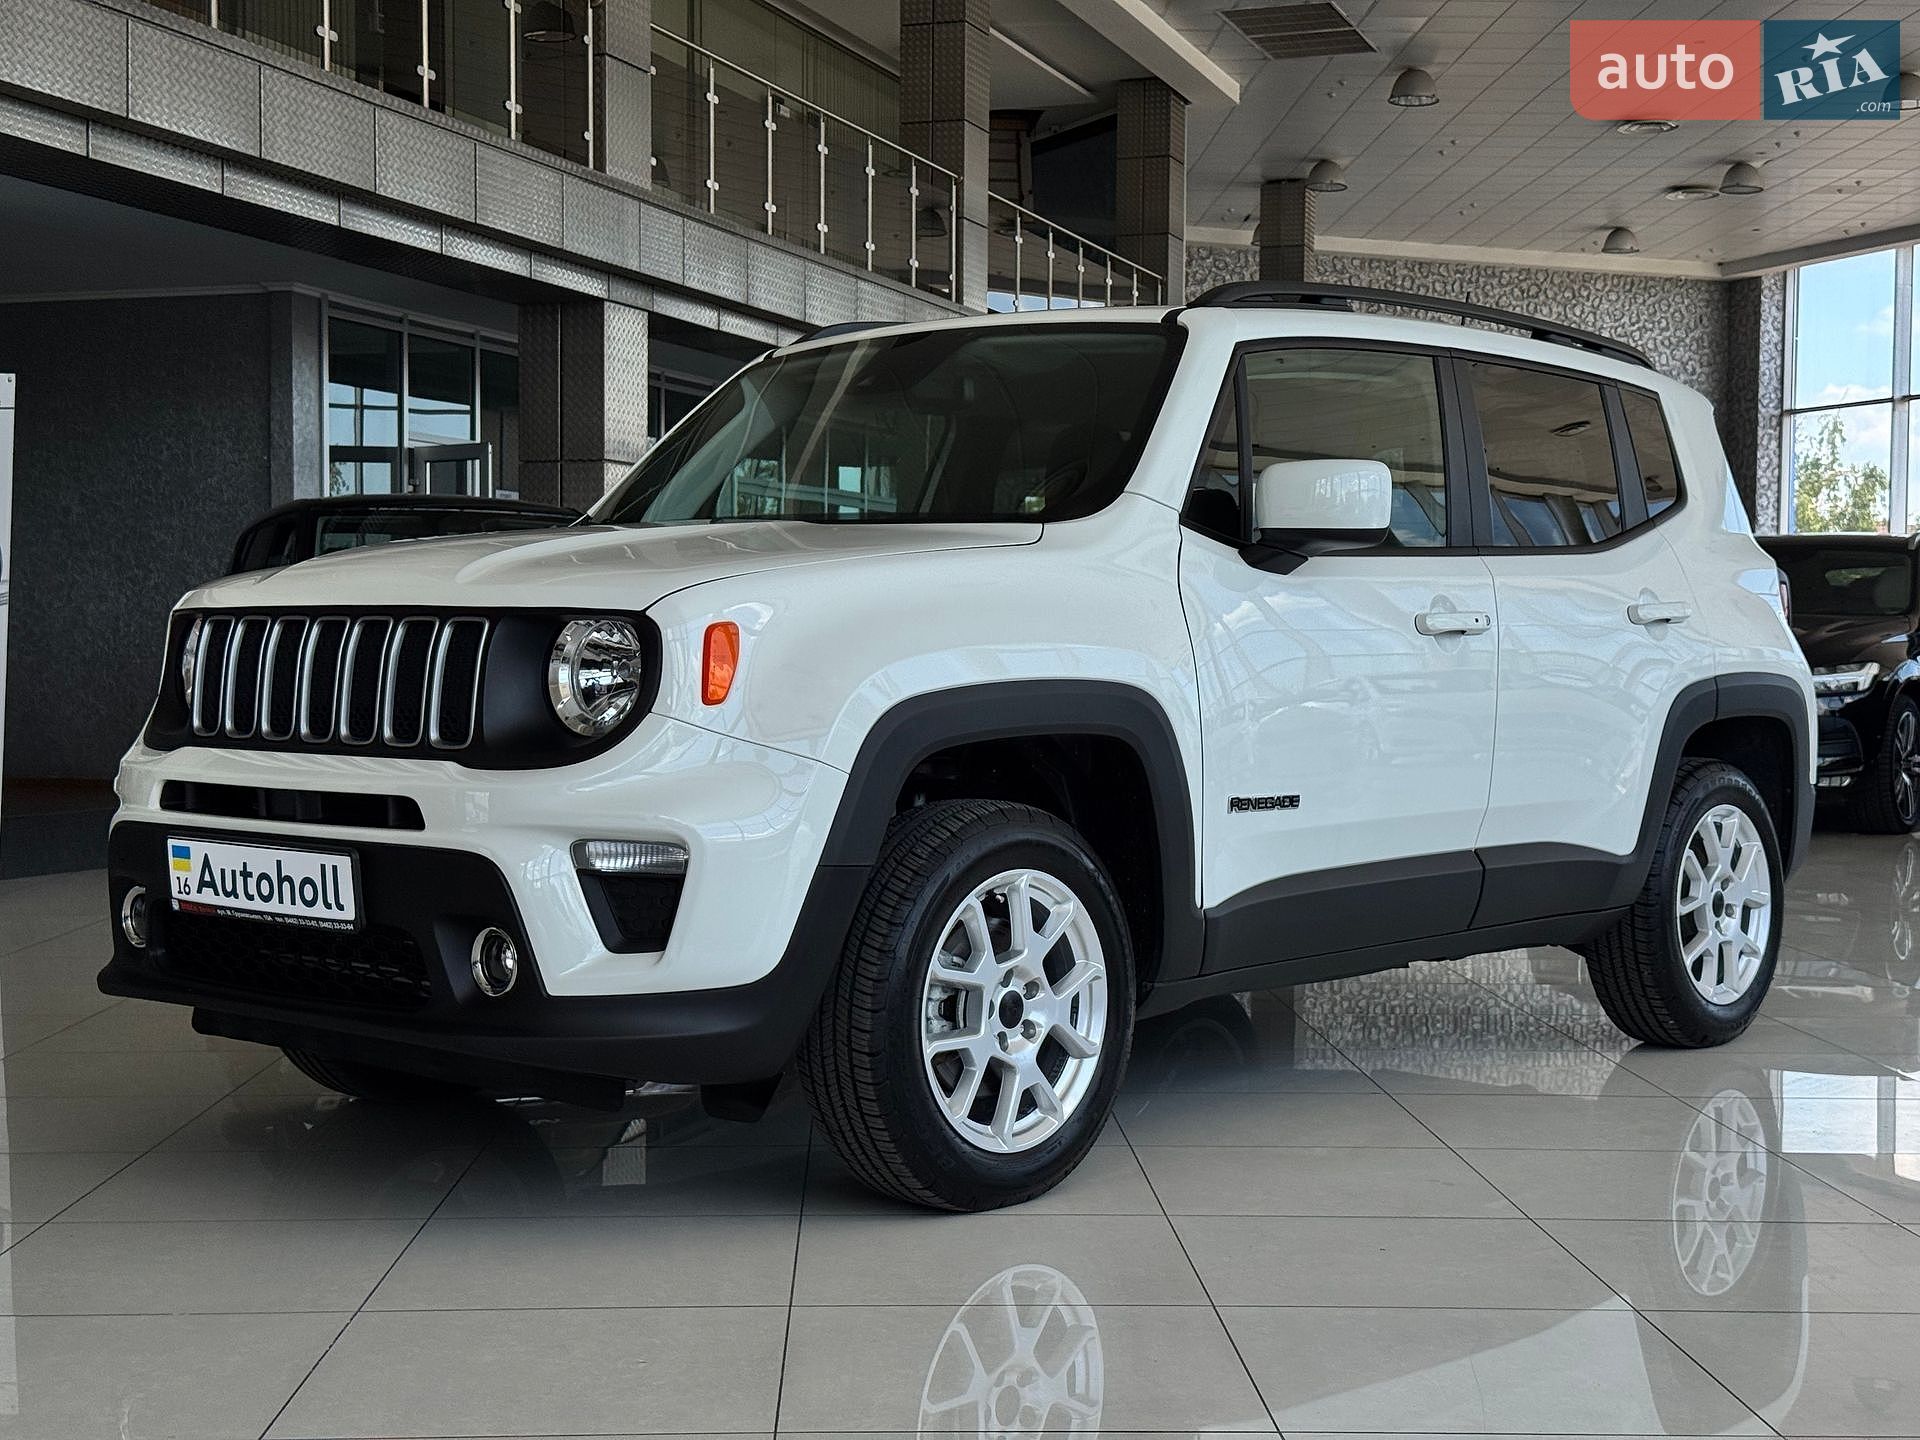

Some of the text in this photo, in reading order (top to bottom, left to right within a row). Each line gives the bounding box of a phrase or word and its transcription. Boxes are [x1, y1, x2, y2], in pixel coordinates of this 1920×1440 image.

[1228, 795, 1300, 814] RENEGADE
[176, 853, 345, 912] 16 Autoholl
